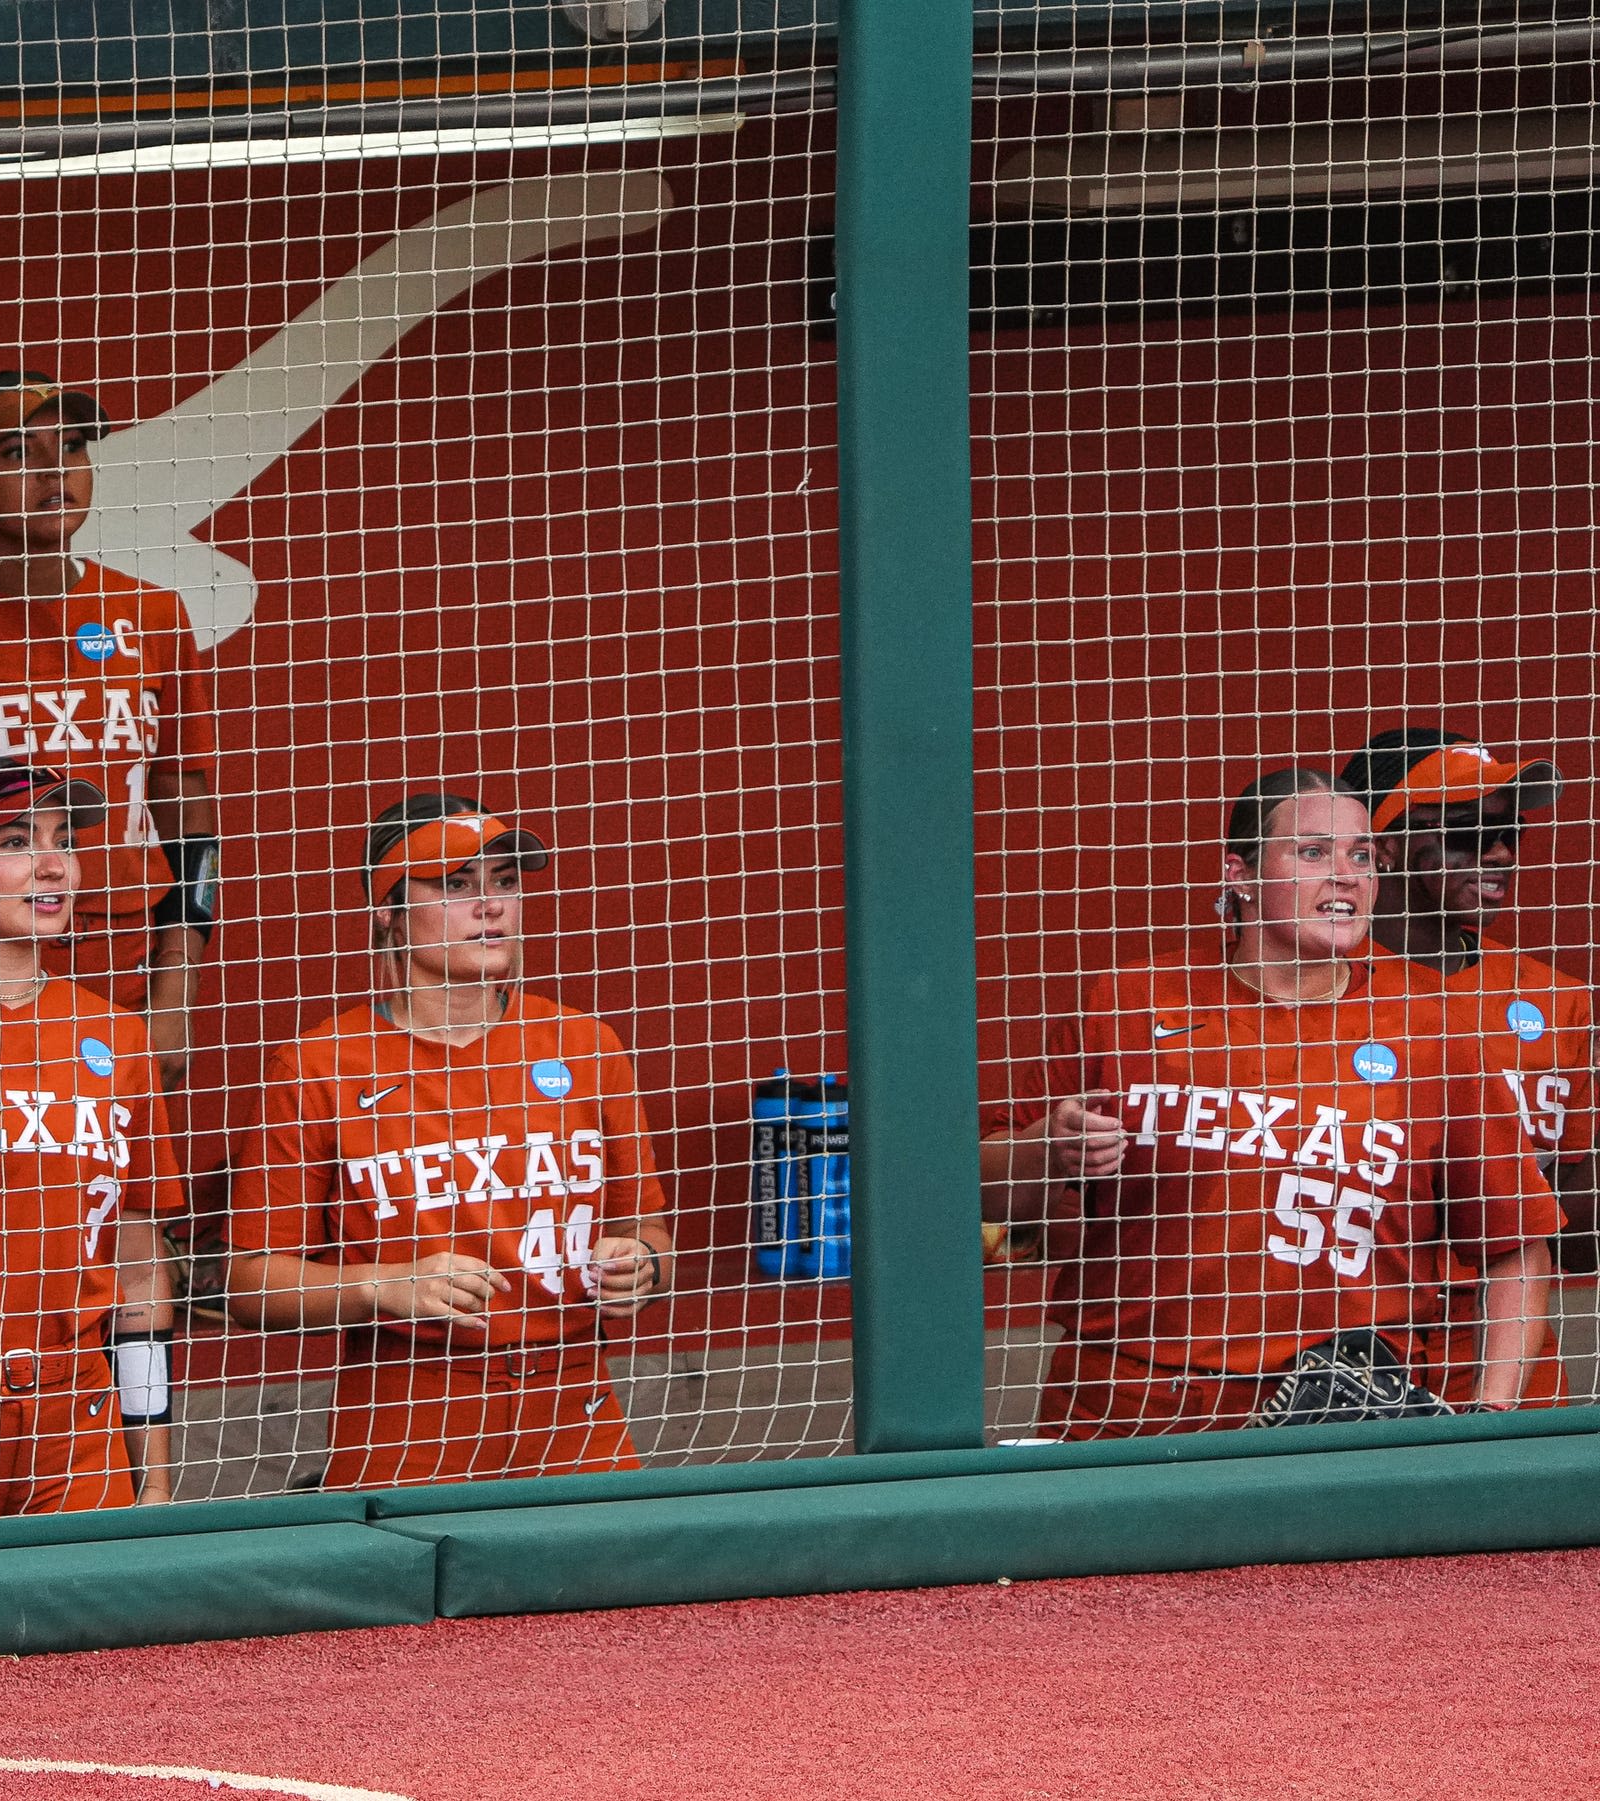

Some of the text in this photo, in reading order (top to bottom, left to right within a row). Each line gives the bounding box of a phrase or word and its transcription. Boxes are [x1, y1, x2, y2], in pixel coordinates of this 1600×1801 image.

[82, 639, 115, 651] NCAA
[112, 618, 140, 658] C
[124, 763, 160, 847] 1
[1512, 1018, 1542, 1031] NCAA
[537, 1076, 570, 1088] NCAA
[1358, 1059, 1393, 1076] NCAA
[1126, 1082, 1406, 1187] TEXAS
[346, 1128, 605, 1221] TEXAS
[518, 1204, 595, 1295] 44
[1267, 1172, 1387, 1279] 55
